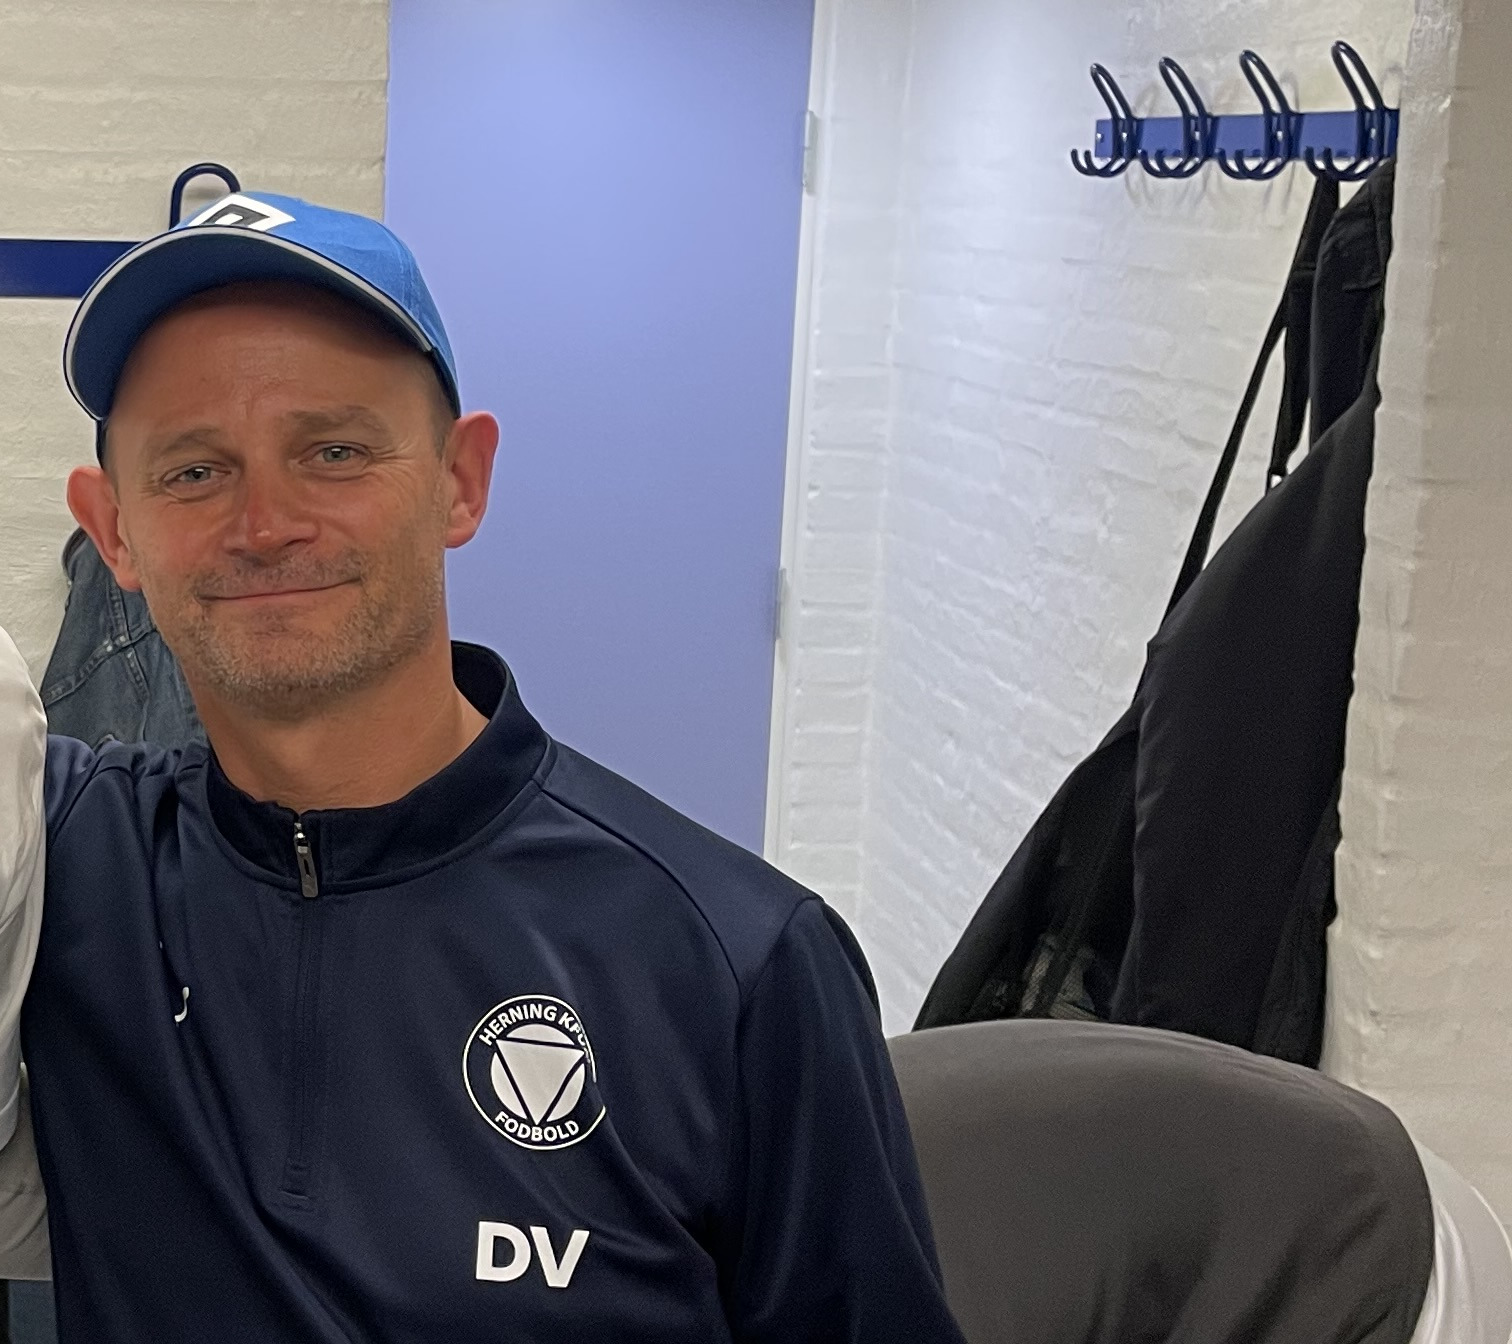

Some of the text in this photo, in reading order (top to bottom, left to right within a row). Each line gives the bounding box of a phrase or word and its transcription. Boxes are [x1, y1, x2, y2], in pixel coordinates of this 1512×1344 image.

[479, 1003, 558, 1046] HERNING
[494, 1110, 580, 1142] FODBOLD
[475, 1219, 590, 1289] DV
